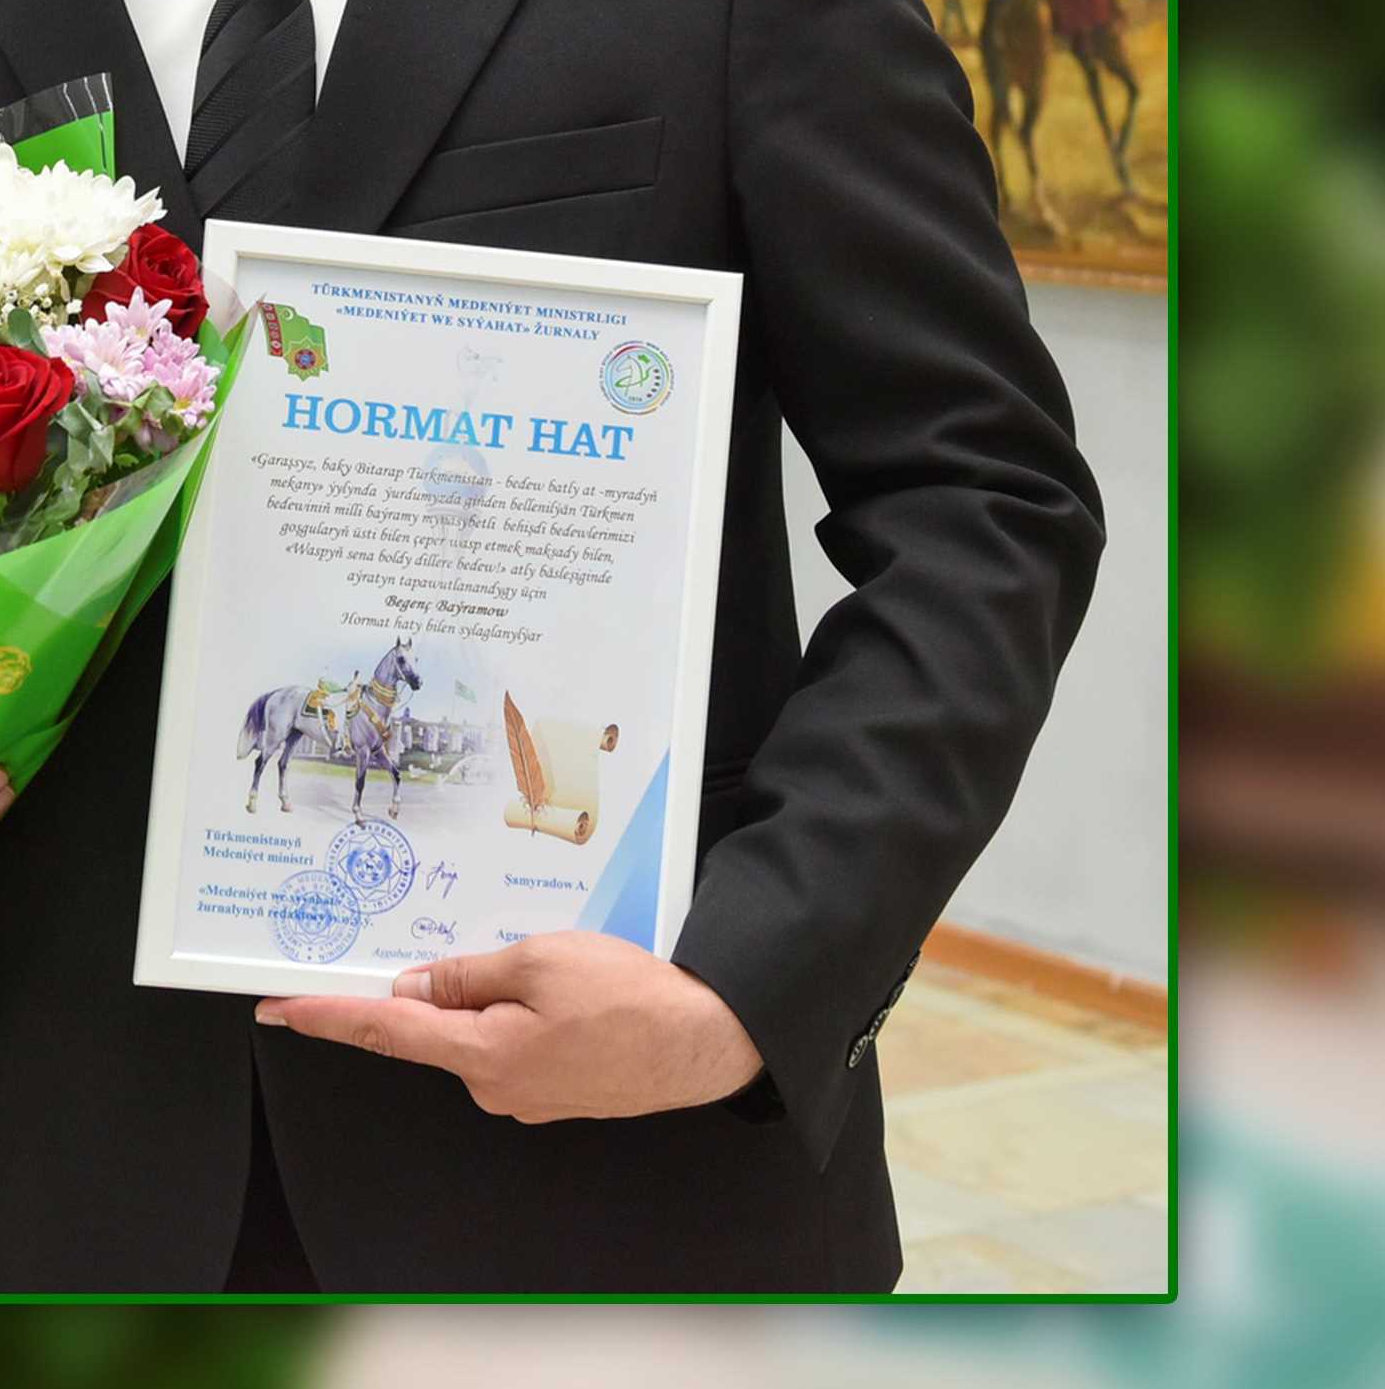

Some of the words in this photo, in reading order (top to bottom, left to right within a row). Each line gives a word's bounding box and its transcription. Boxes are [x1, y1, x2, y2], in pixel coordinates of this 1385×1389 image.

[311, 283, 444, 306] TÜRKMENISTANYŇ
[448, 297, 532, 316] MEDENIÝET
[535, 306, 627, 326] MINISTRLIGI
[335, 305, 427, 323] «MEDENIÝET
[431, 314, 453, 325] WE
[457, 316, 530, 334] SYÝAHAT»
[534, 323, 601, 340] ŽURNALY
[281, 393, 513, 449] HORMAT
[527, 417, 634, 460] HAT
[321, 457, 352, 477] baky
[354, 462, 404, 481] Bitarap
[505, 474, 545, 490] bedew
[582, 485, 596, 497] at
[270, 475, 324, 493] mekany»
[579, 504, 635, 523] Türkmen
[334, 502, 362, 517] milli
[365, 505, 419, 526] baýramy
[380, 528, 410, 543] bilen
[484, 540, 524, 557] etmek
[582, 548, 614, 564] bilen,
[346, 549, 374, 561] sena
[378, 550, 412, 570] boldy
[510, 562, 536, 578] atly
[384, 594, 434, 612] Begenç
[435, 598, 510, 618] Baýramow
[341, 611, 391, 629] Hormat
[393, 615, 424, 634] haty
[425, 619, 457, 635] bilen
[204, 829, 302, 848] Türkmenistanyň
[203, 845, 265, 863] Medeniýet
[267, 851, 314, 866] ministri
[575, 880, 589, 891] A.
